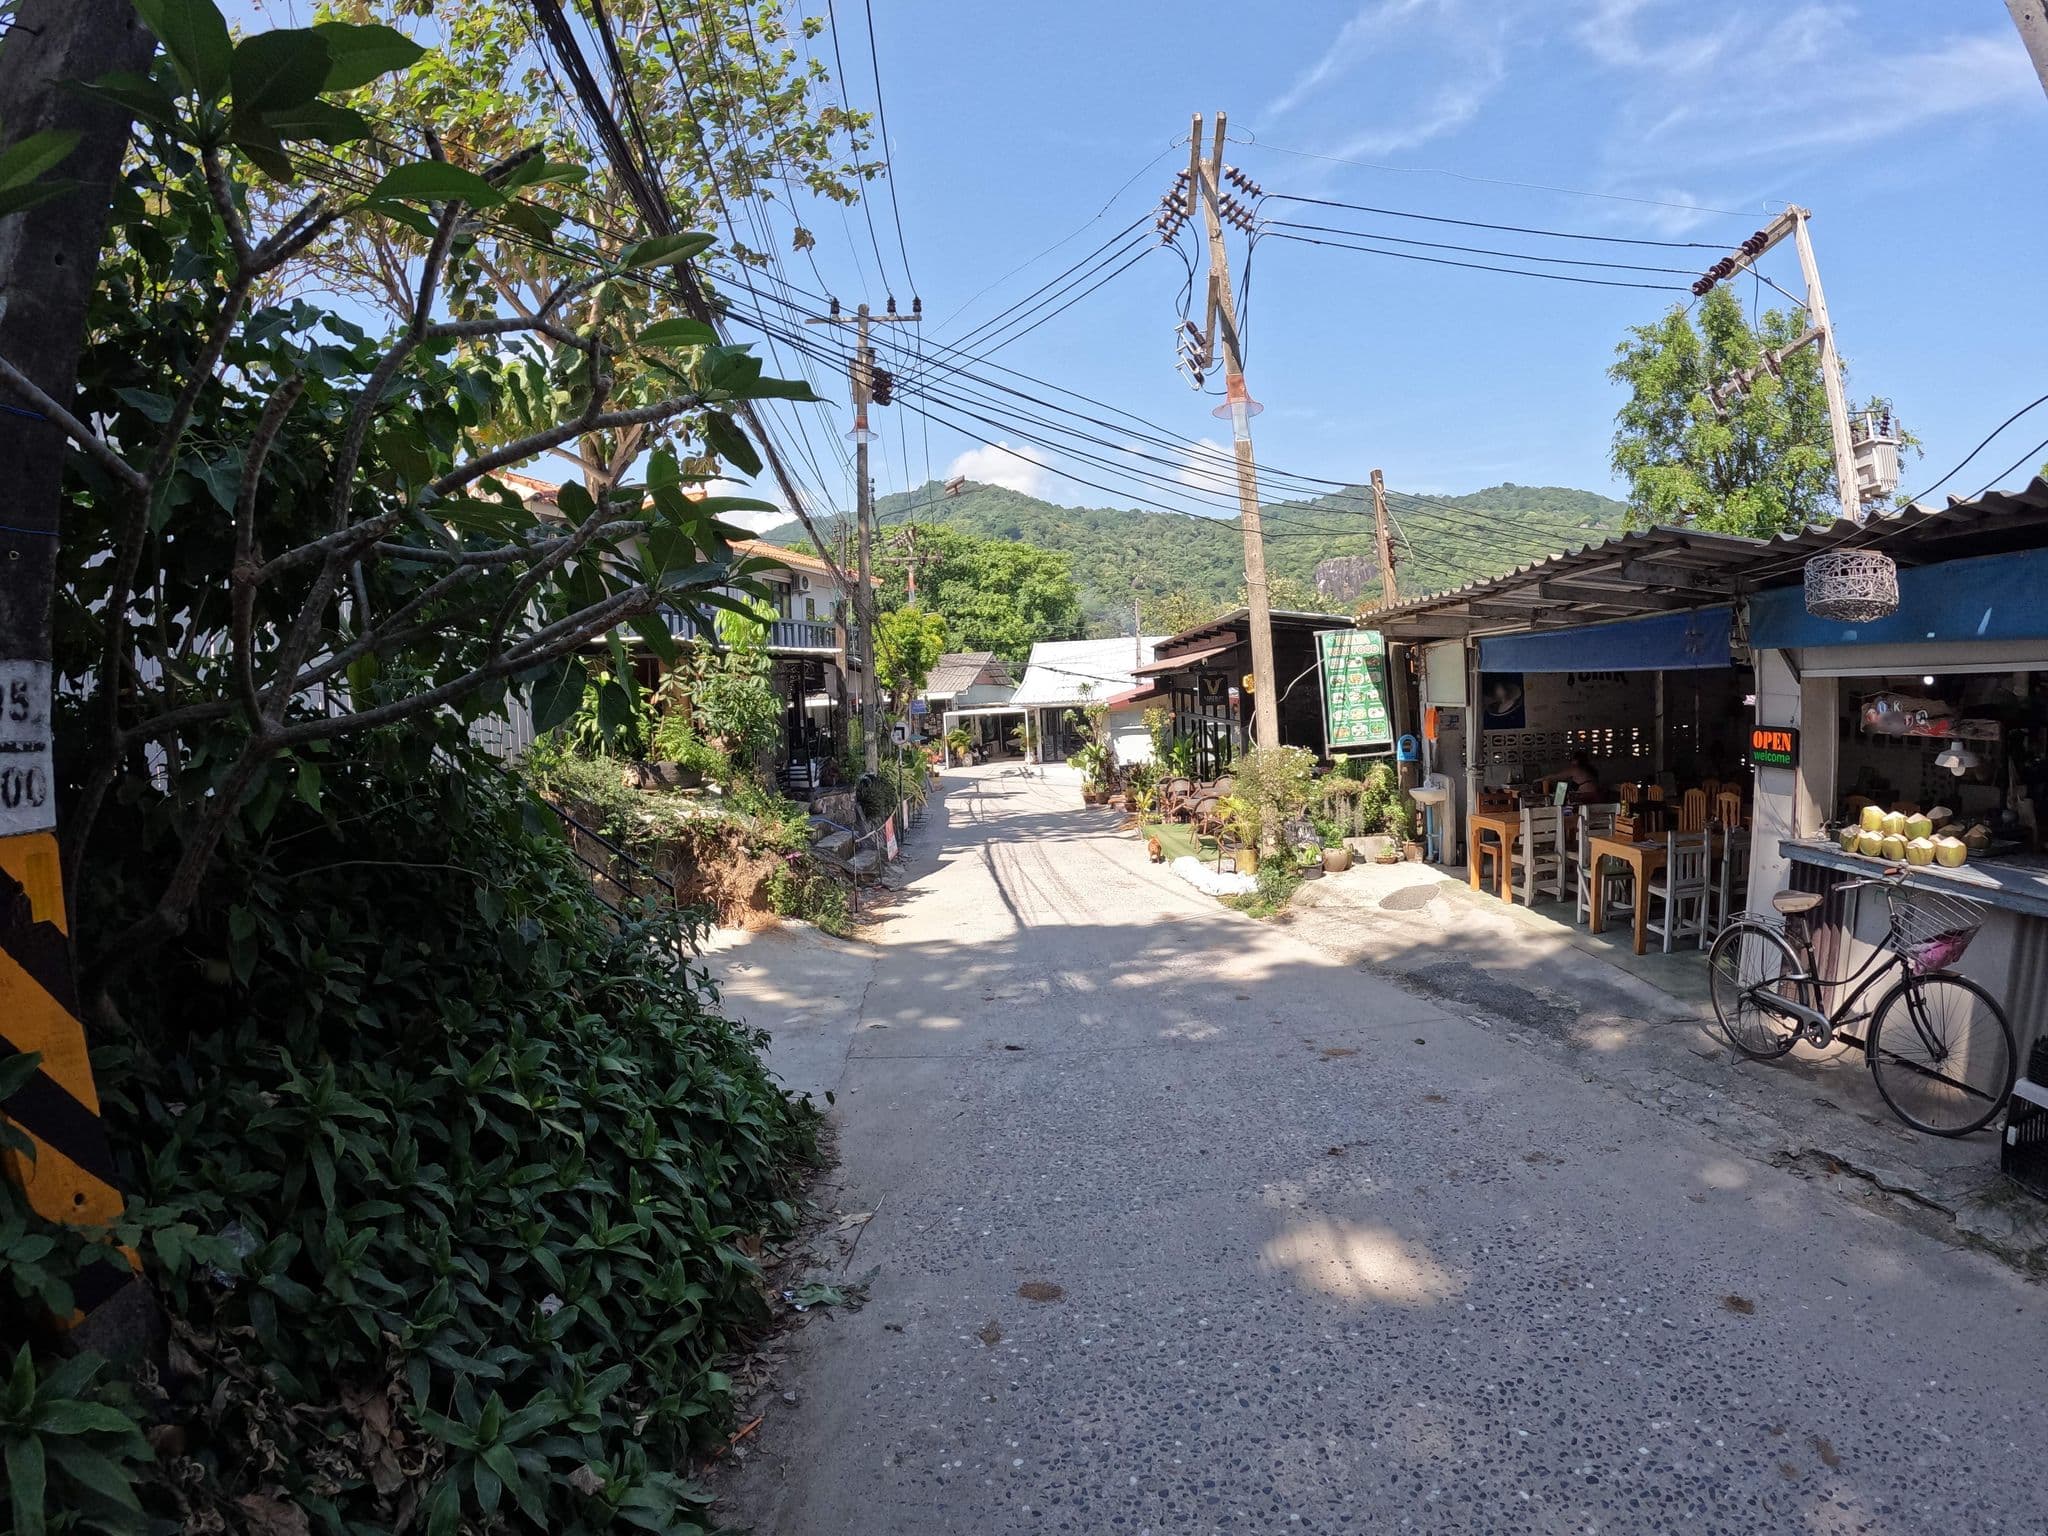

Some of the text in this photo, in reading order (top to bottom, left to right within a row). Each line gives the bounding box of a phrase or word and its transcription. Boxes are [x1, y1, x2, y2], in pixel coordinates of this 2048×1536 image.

[1351, 645, 1379, 655] FOOD
[1753, 731, 1792, 751] OPEN
[1754, 752, 1791, 764] welcome
